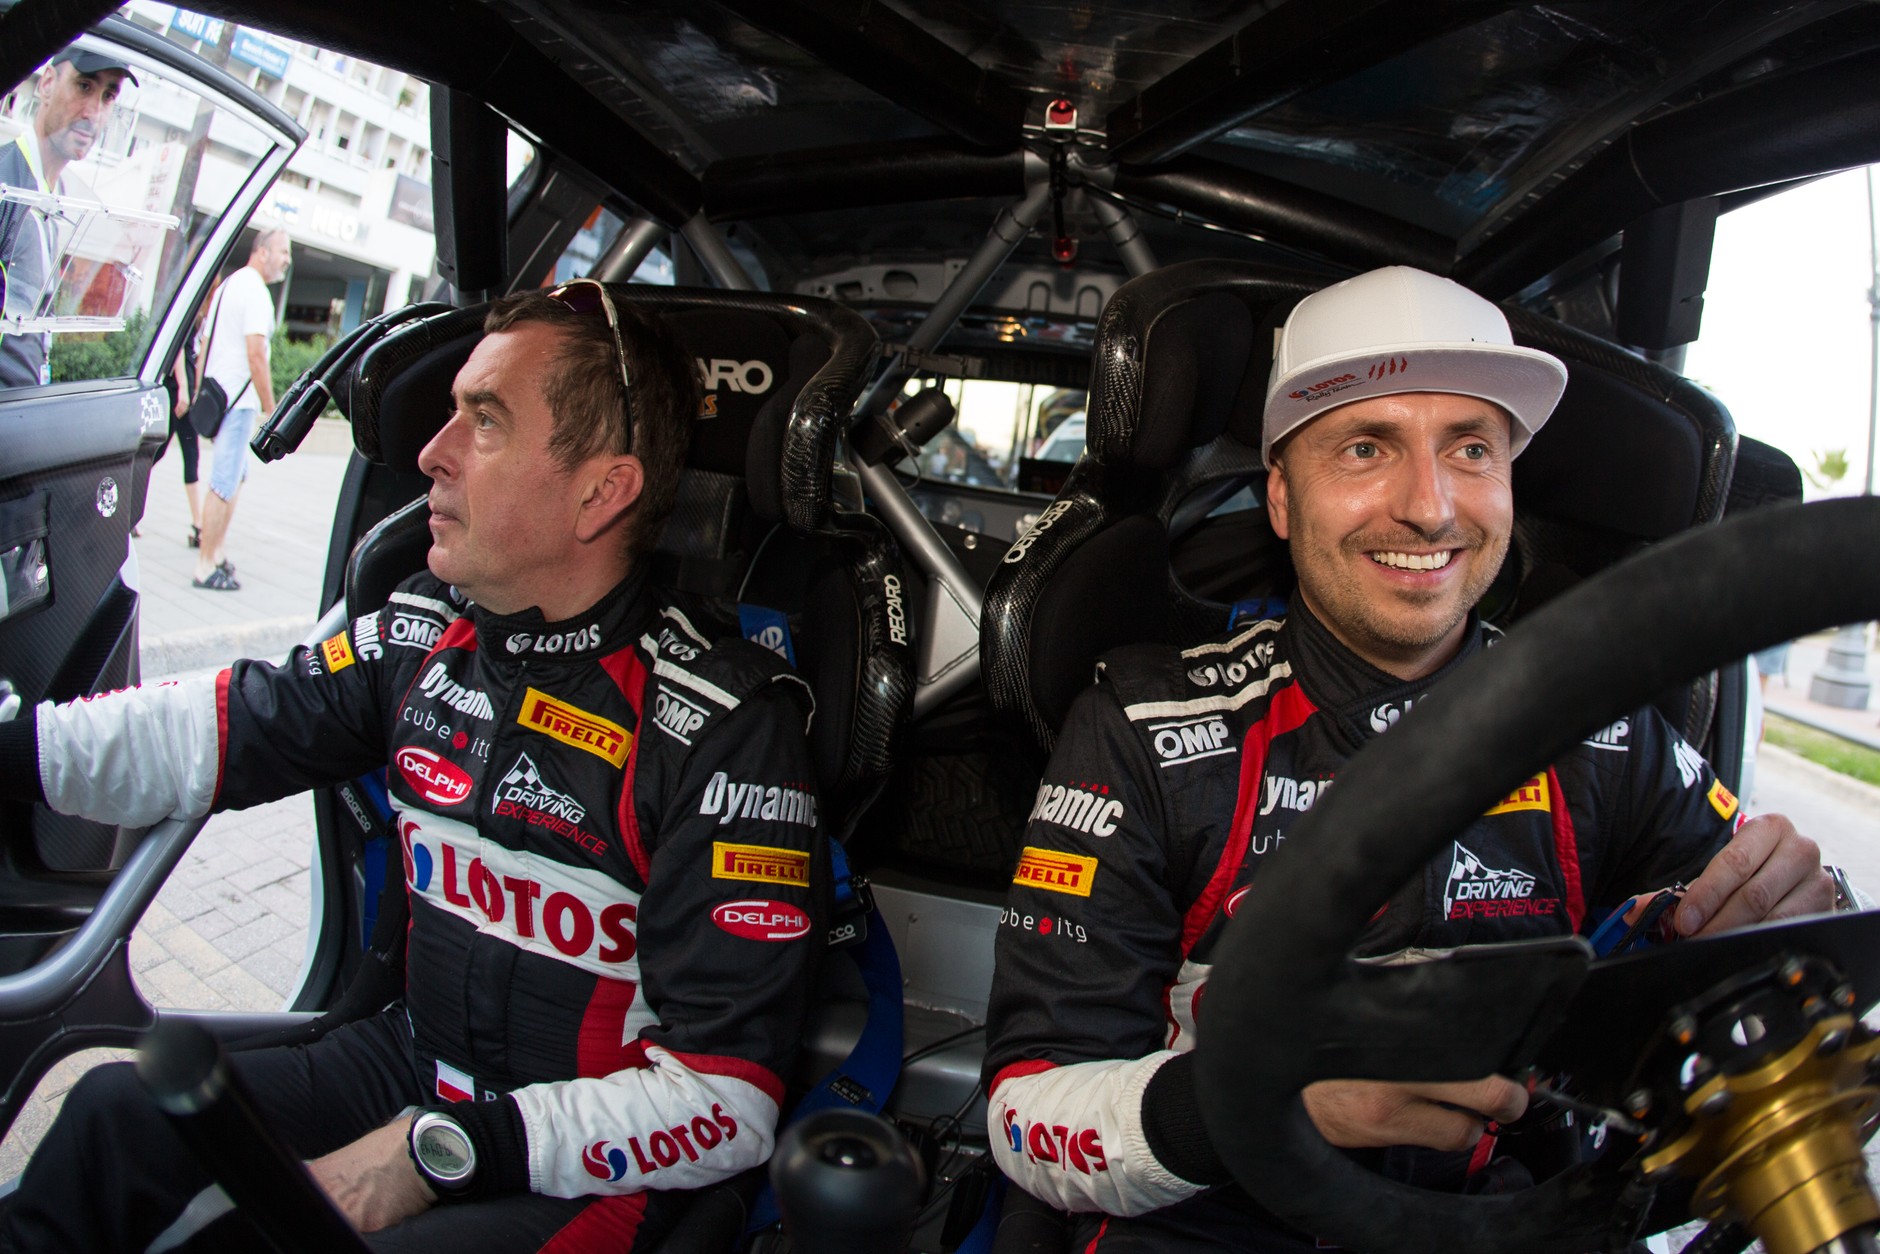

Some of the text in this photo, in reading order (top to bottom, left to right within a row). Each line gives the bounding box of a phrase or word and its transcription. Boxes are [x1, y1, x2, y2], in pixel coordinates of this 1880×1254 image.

[1306, 389, 1332, 402] Rally
[1307, 373, 1356, 392] LOTOS
[1003, 501, 1073, 563] RECARO
[884, 574, 907, 646] RECARO
[390, 617, 443, 646] OMP
[533, 624, 601, 653] LOTOS
[403, 706, 451, 740] cube
[530, 700, 625, 757] PIRELLI
[656, 693, 704, 736] OMP
[1154, 720, 1229, 759] OMP
[403, 755, 467, 796] DELPHI
[504, 786, 585, 824] DRIVING
[699, 771, 818, 828] Dynamic
[1029, 781, 1124, 838] namic
[497, 801, 608, 857] EXPERIENCE
[724, 851, 805, 880] PIRELLI
[1016, 860, 1082, 888] RELLI
[441, 842, 637, 963] LOTOS
[1450, 898, 1559, 919] EXPERIENCE
[1456, 880, 1536, 900] DRIVING
[724, 910, 803, 927] DELPHI
[1057, 917, 1088, 942] itg
[628, 1103, 738, 1175] LOTOS
